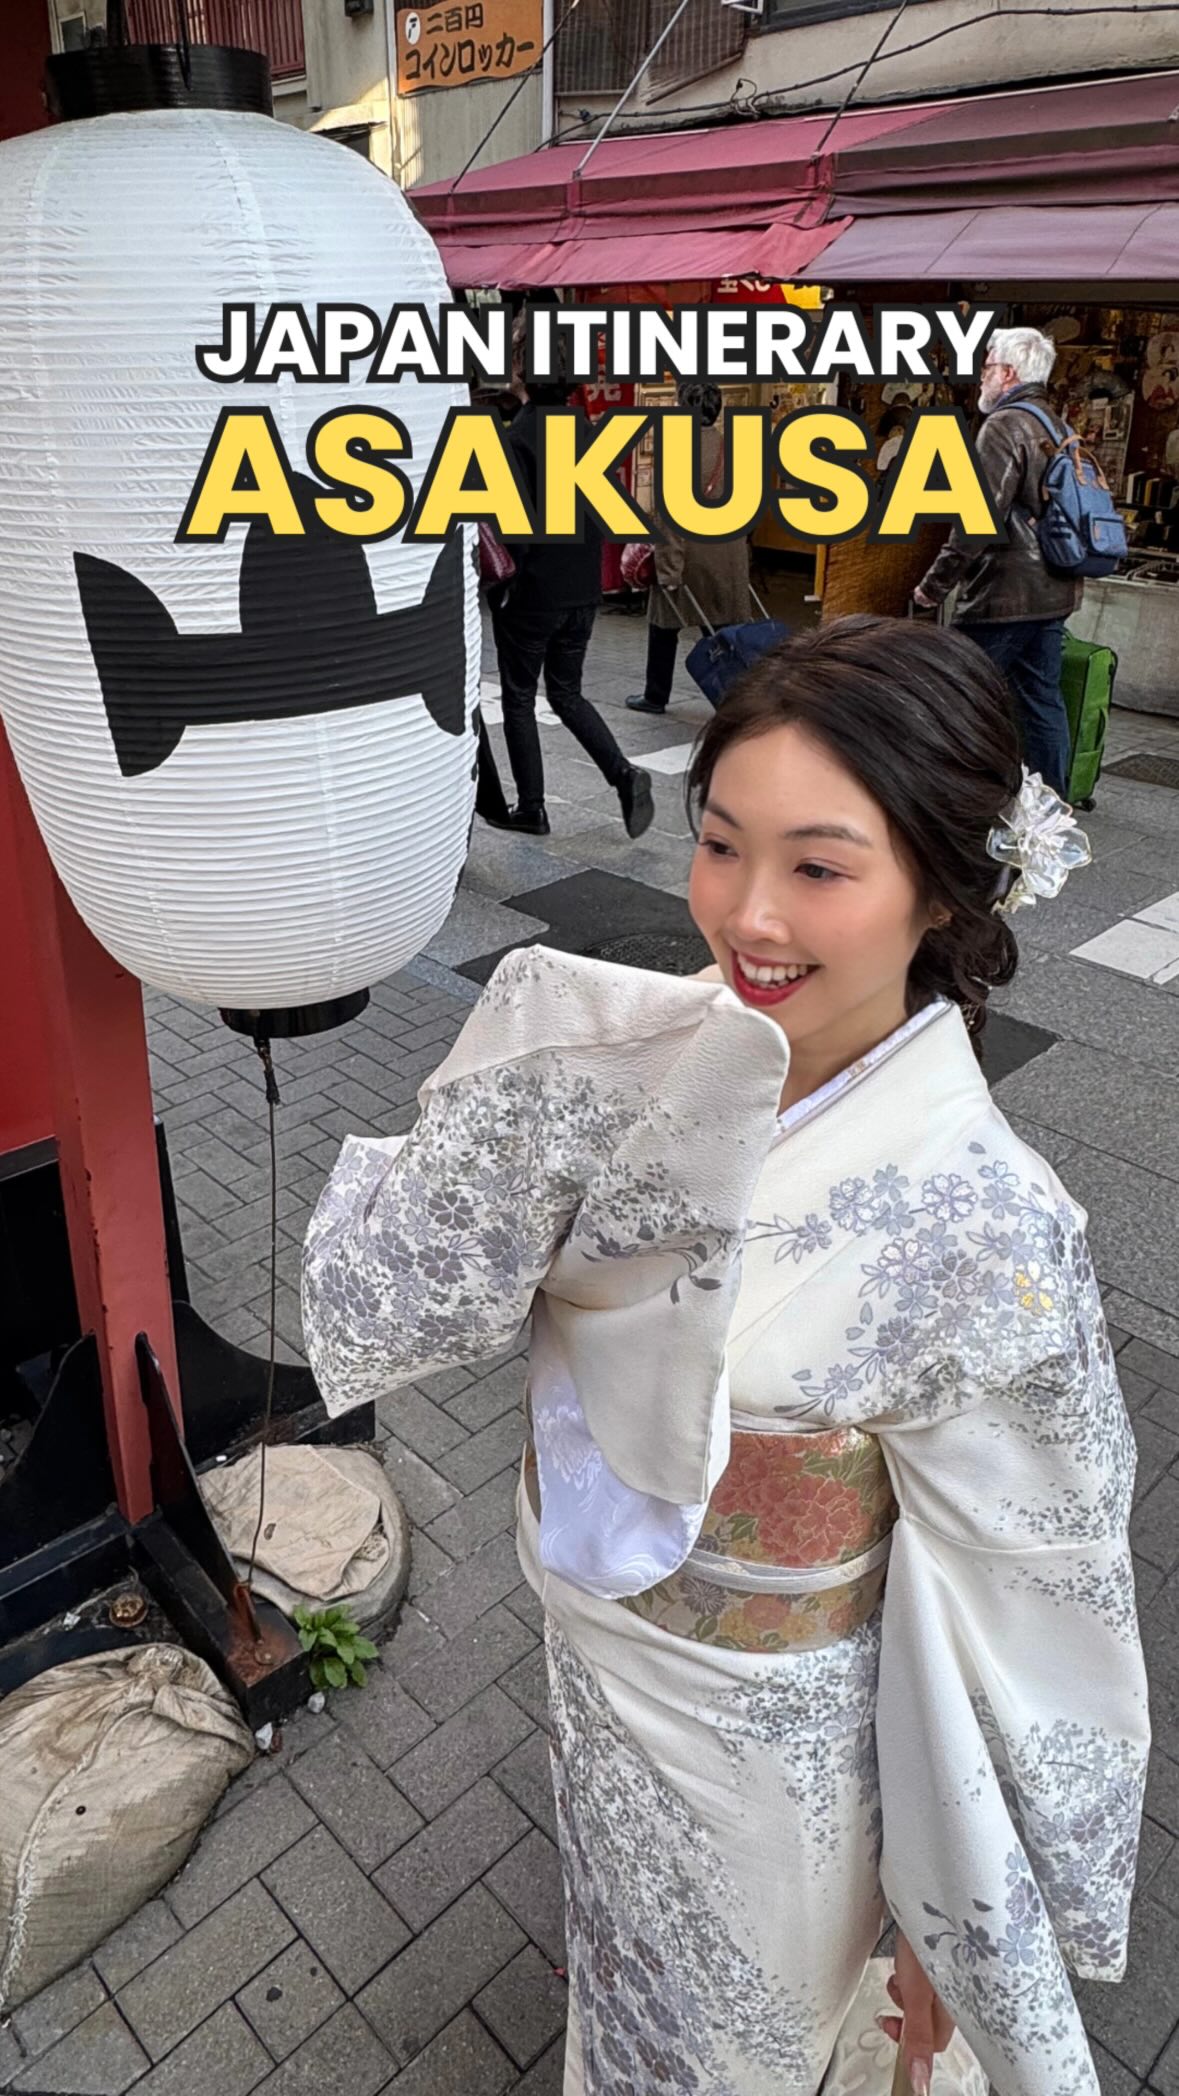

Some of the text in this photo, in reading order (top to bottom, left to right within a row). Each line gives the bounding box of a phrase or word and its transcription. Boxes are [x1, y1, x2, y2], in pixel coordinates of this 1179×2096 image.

[426, 2, 484, 35] 二百円
[405, 32, 535, 81] コインロッカー
